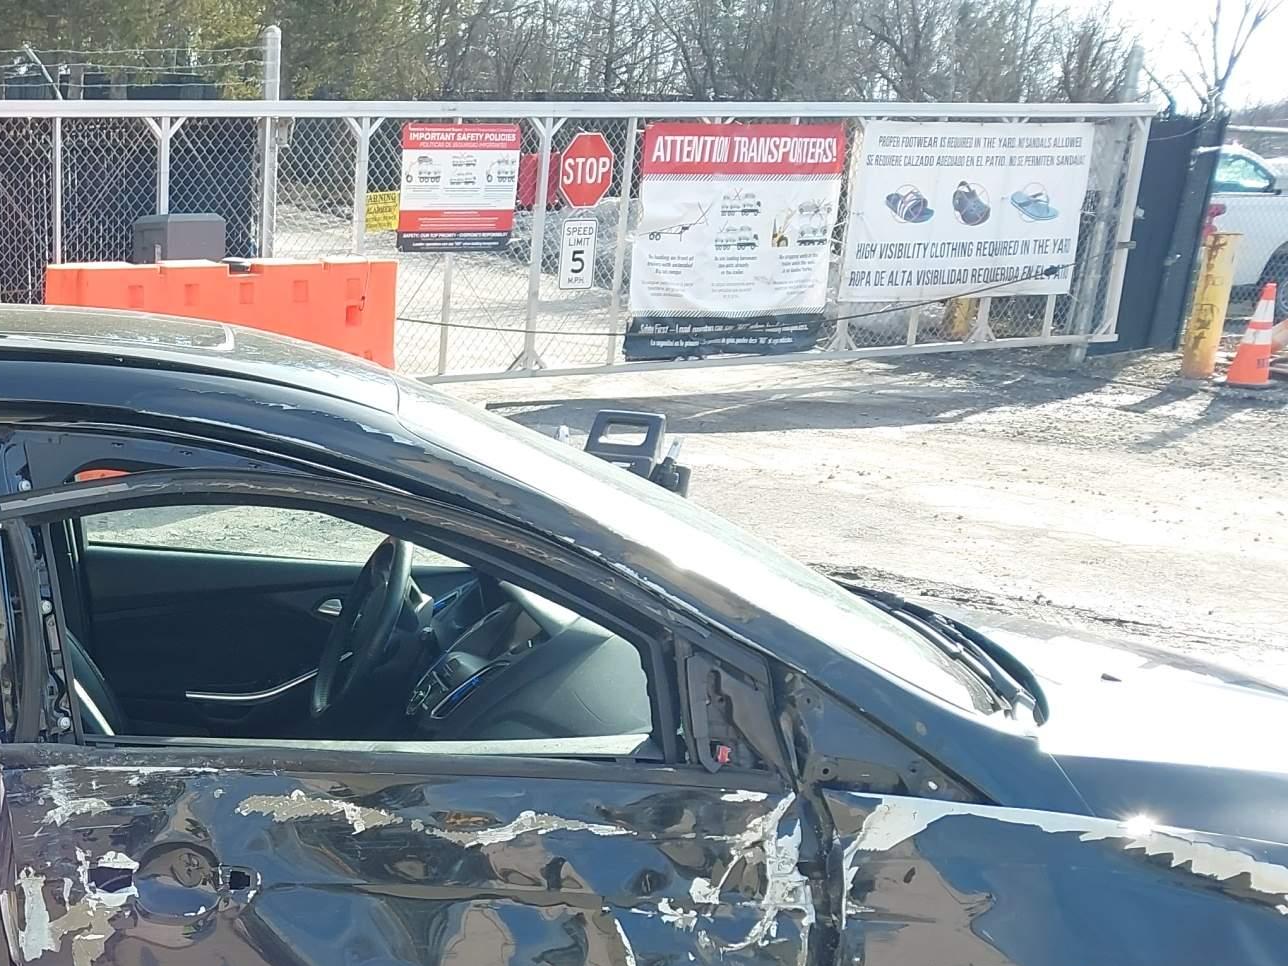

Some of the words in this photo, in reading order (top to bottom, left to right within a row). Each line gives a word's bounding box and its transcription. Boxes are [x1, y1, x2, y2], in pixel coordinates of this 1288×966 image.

[409, 132, 456, 140] IMPORTANT
[457, 132, 484, 140] SAFETY
[484, 133, 516, 142] POLICIES
[878, 136, 900, 148] PROPER
[902, 136, 938, 148] FOOTWEAR
[940, 137, 946, 148] IS
[947, 137, 974, 148] REQUIRED
[974, 138, 982, 148] IN
[984, 138, 996, 148] THE
[1025, 138, 1052, 148] SANDALS
[652, 136, 730, 162] ATTENTION
[733, 137, 838, 162] TRANSPORTERS!
[866, 154, 874, 166] SE
[875, 155, 902, 166] REQUIERE
[904, 156, 934, 166] CALZADO
[966, 156, 974, 166] EN
[976, 156, 983, 166] EL
[564, 157, 610, 184] STOP
[566, 227, 594, 236] SPEED
[568, 238, 590, 246] LIMIT
[856, 243, 878, 259] HIGH
[879, 242, 930, 259] VISIBILITY
[930, 242, 974, 258] CLOTHING
[976, 240, 1019, 257] REQUIRED
[1020, 240, 1030, 254] IN
[1034, 239, 1050, 254] THE
[570, 250, 585, 273] 5
[848, 271, 871, 286] ROPA
[874, 271, 886, 286] DE
[887, 270, 912, 286] ALTA
[916, 269, 968, 286] VISIBILIDAD
[971, 266, 1020, 283] REQUERIDA
[1021, 265, 1033, 280] EN
[1035, 265, 1045, 280] EL
